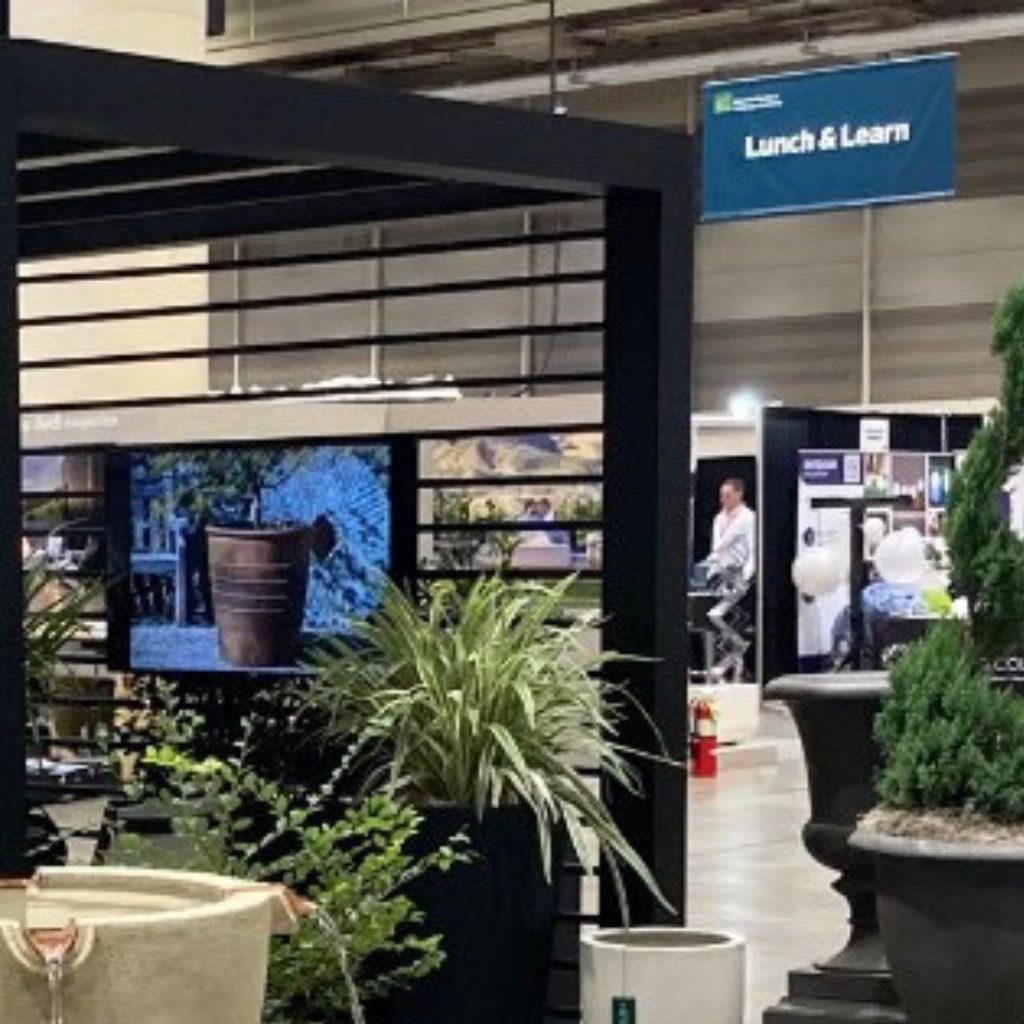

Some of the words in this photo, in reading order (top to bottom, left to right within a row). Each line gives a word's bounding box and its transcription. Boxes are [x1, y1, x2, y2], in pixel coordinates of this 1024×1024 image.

[744, 129, 815, 159] Lunch
[817, 126, 837, 151] &
[840, 122, 910, 148] Learn
